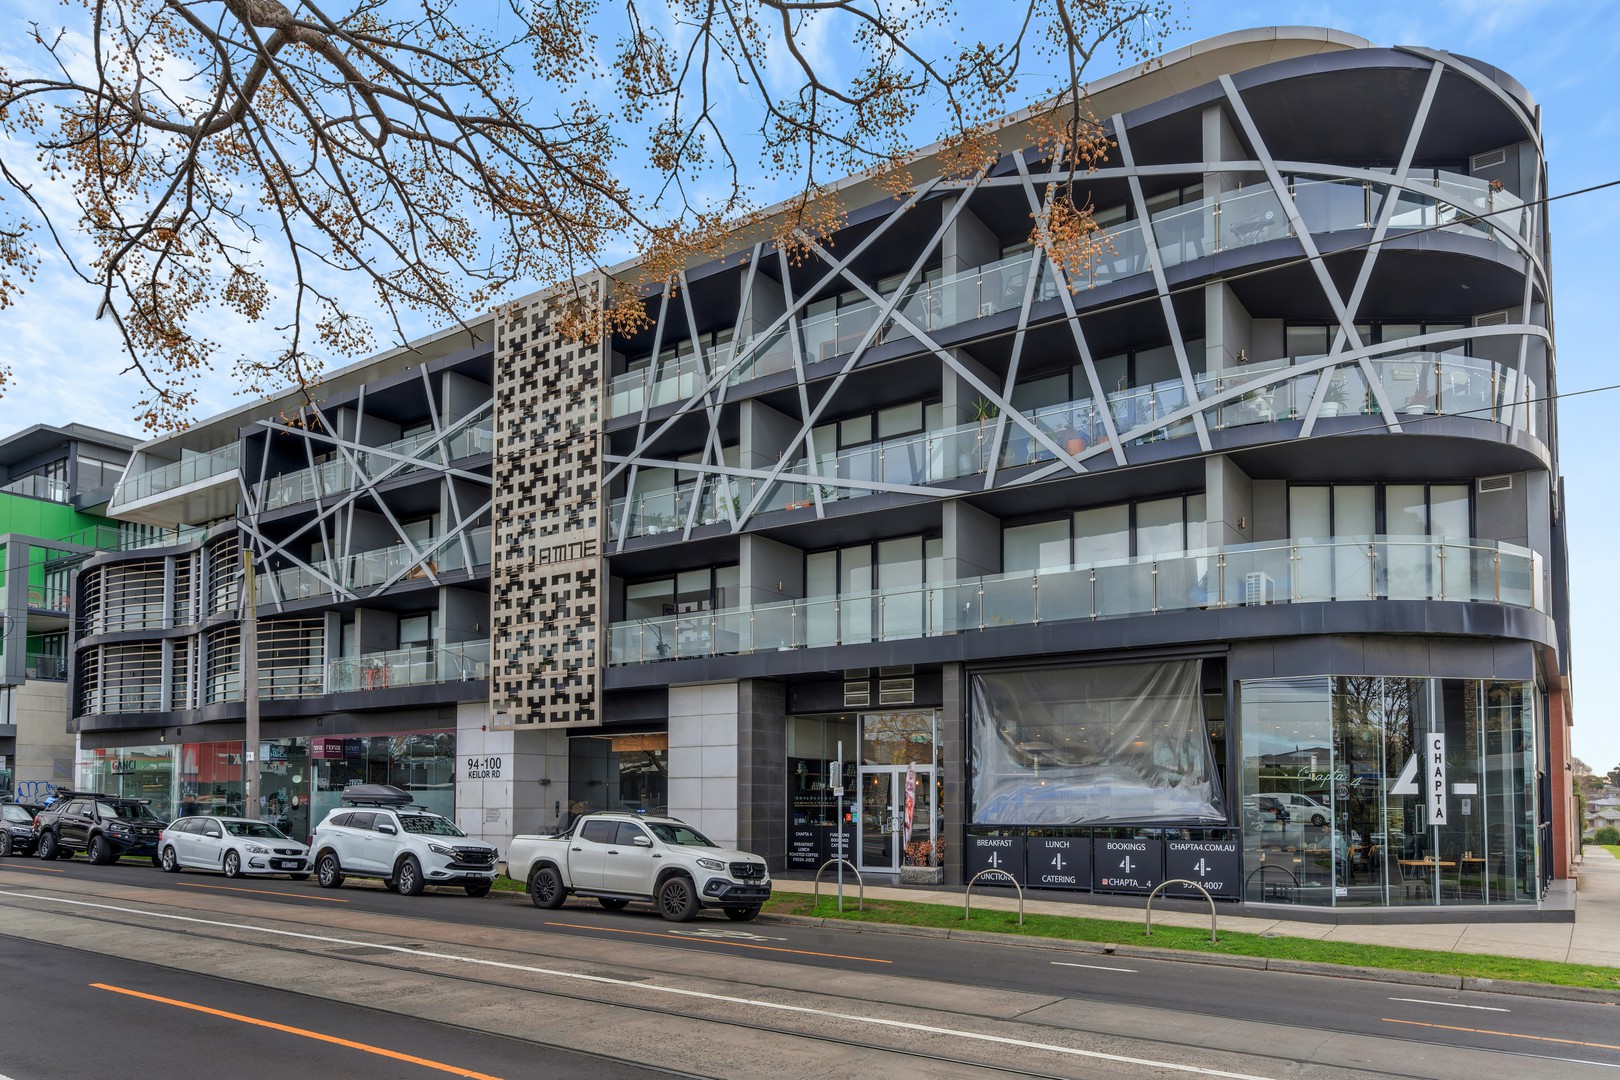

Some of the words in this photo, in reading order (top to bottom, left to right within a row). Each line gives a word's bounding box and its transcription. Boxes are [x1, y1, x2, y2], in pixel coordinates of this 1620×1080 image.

[467, 757, 502, 770] 94-100
[468, 770, 490, 778] KEILOR
[491, 770, 501, 778] RD
[1297, 765, 1345, 788] Capta
[1350, 776, 1363, 788] 4
[1434, 739, 1443, 818] CHAPTA
[977, 839, 1013, 847] BREAKFAST
[1107, 843, 1146, 851] BOOKINGS
[1169, 843, 1235, 852] CHAPTA4.COM.AU
[977, 872, 1014, 881] UNCTION
[1041, 874, 1076, 884] CATERING
[1203, 881, 1223, 890] 4007
